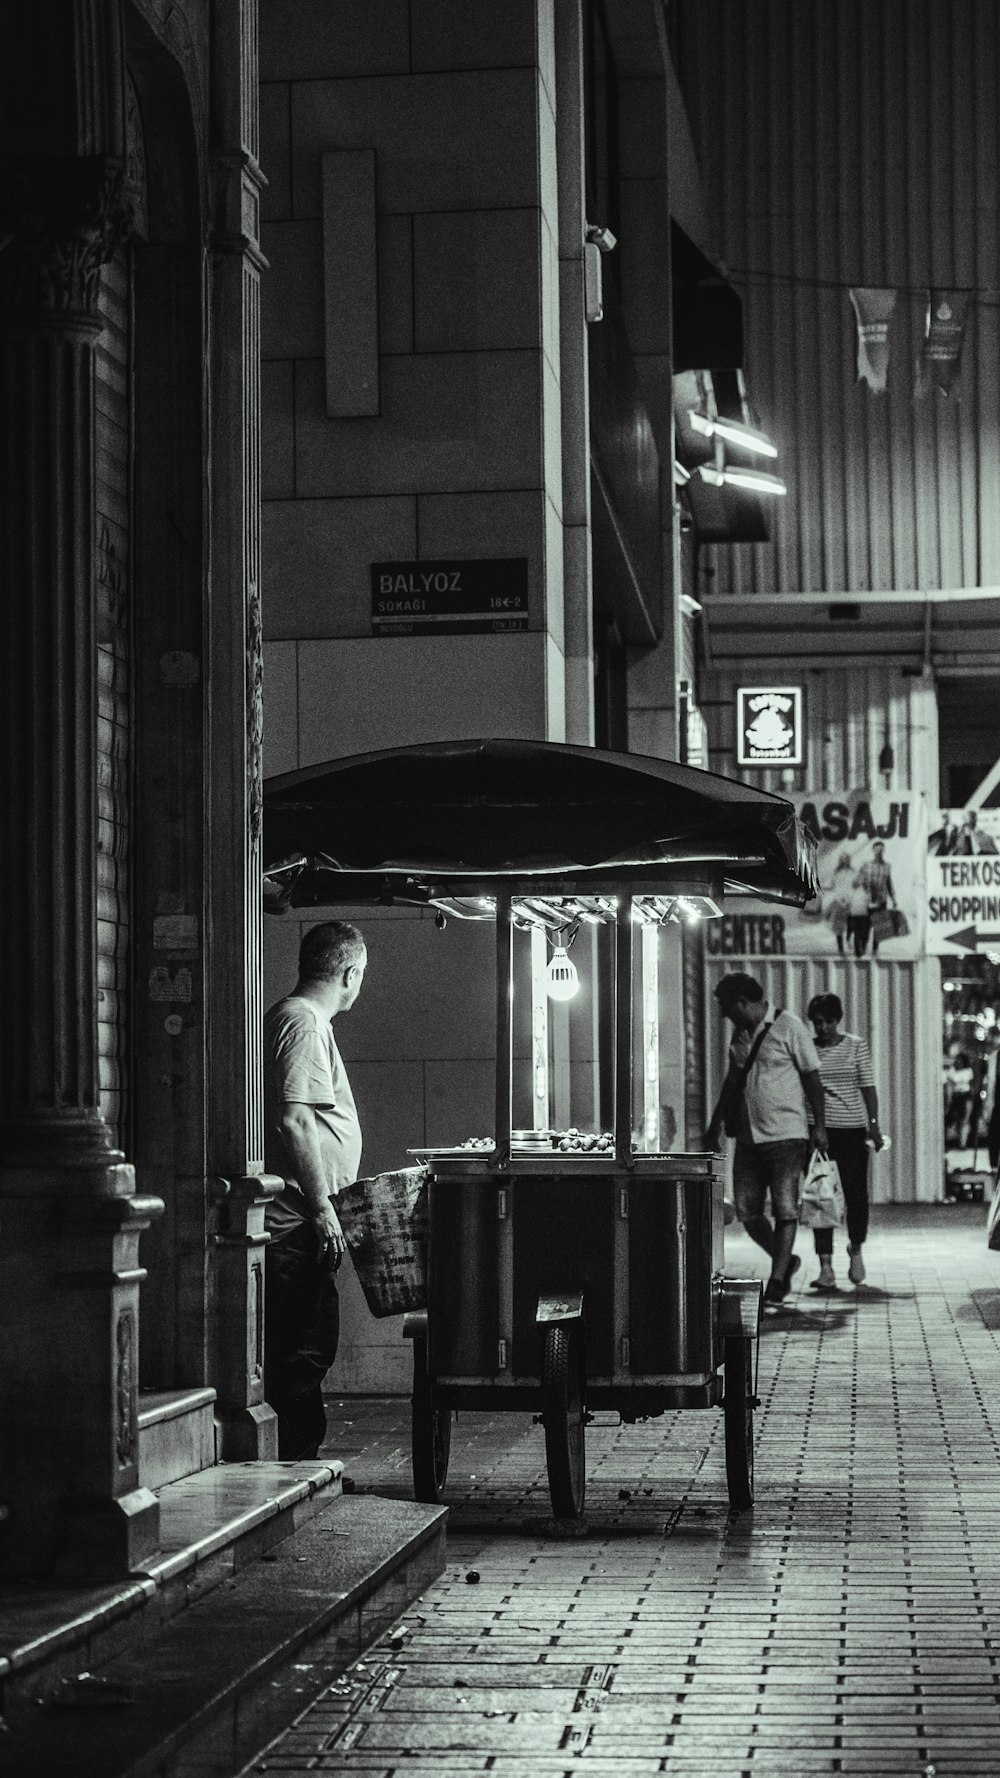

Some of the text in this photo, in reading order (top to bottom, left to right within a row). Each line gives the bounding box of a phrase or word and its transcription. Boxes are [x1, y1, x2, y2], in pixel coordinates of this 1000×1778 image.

[380, 572, 461, 593] BALYOZ
[378, 597, 426, 612] SOKAĞI
[799, 802, 909, 841] ASAJI
[940, 861, 1000, 887] TERKOS
[928, 896, 1000, 923] SHOPPIN
[707, 914, 786, 954] CENTER
